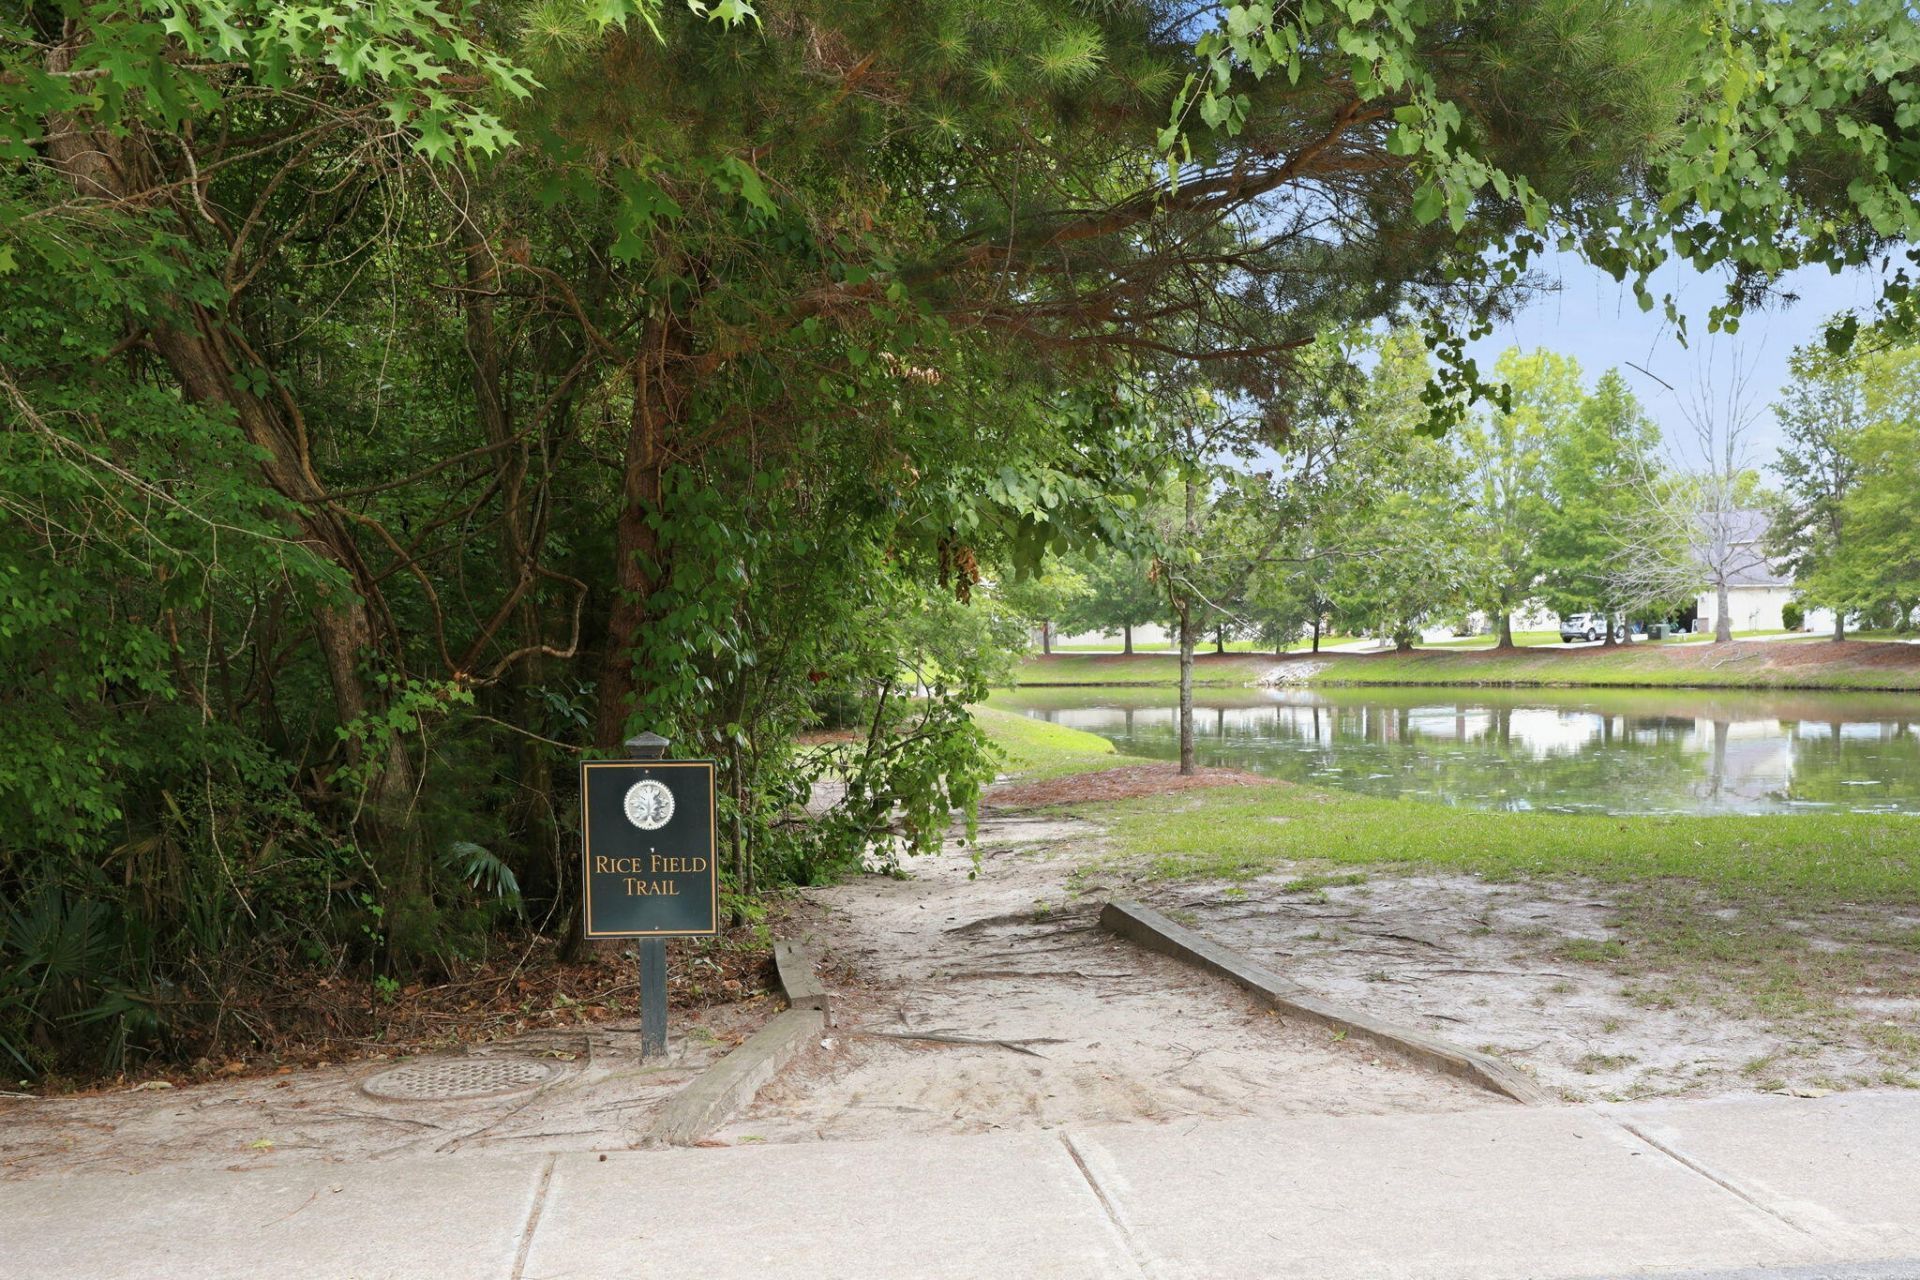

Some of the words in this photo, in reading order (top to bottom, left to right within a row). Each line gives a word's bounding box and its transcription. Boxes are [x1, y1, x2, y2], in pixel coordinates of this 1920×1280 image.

[596, 855, 642, 873] RICE
[651, 854, 707, 873] FIELD
[622, 877, 680, 896] TRAIL
